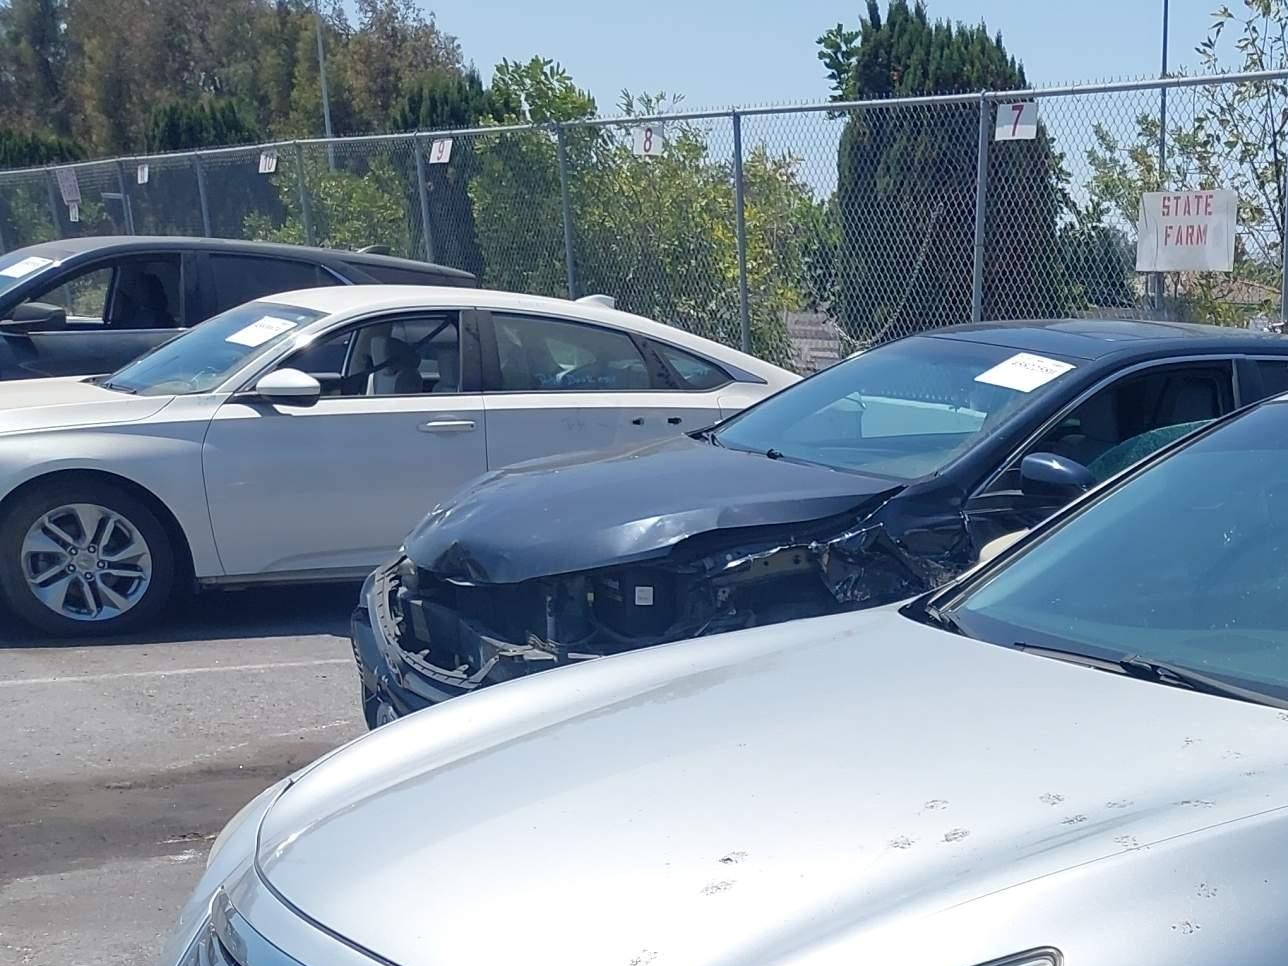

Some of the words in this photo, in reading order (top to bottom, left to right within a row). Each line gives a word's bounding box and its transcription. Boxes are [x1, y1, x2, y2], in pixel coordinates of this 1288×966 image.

[1011, 103, 1025, 137] 7
[437, 142, 445, 161] 9
[643, 127, 653, 153] 8
[263, 153, 274, 171] 10
[1161, 194, 1214, 217] STATE
[1164, 223, 1208, 246] FARM
